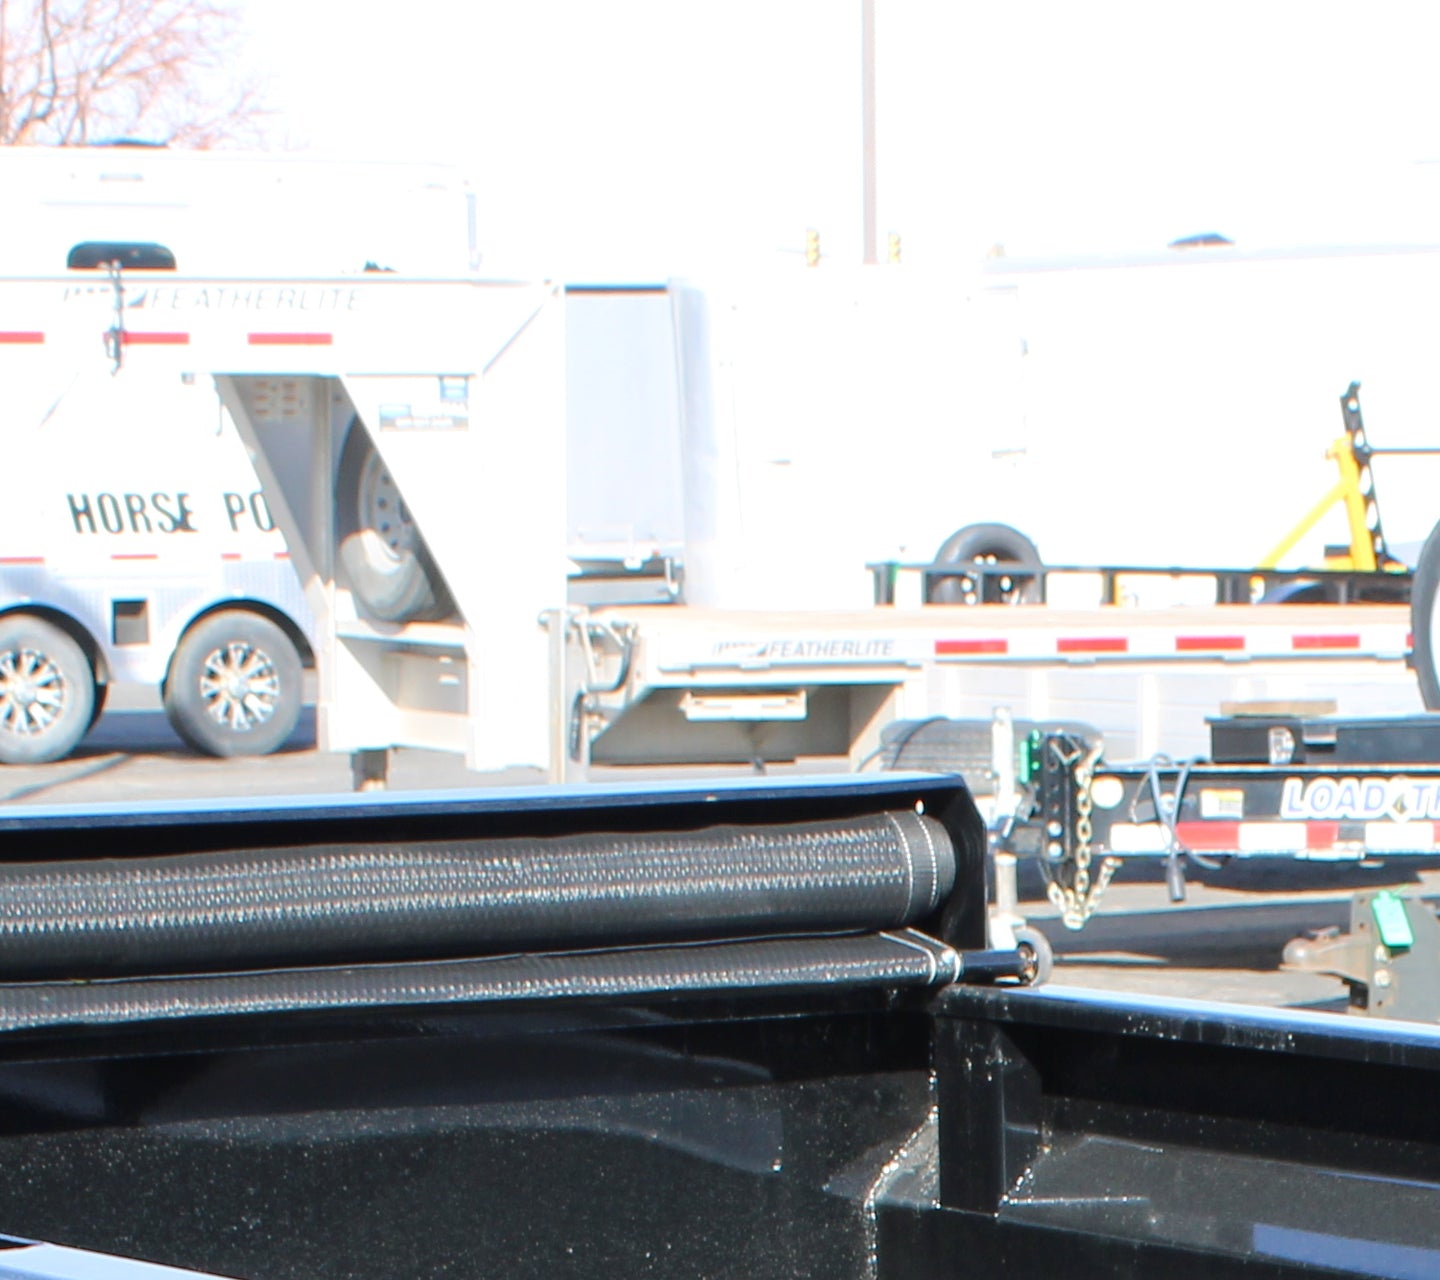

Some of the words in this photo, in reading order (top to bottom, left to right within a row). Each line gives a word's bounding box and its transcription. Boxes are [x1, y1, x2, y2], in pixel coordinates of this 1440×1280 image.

[150, 286, 360, 311] FEATHERLITE
[66, 492, 199, 535] HORSE
[767, 638, 895, 658] FEATHERLITE
[1282, 779, 1387, 818] LOAD
